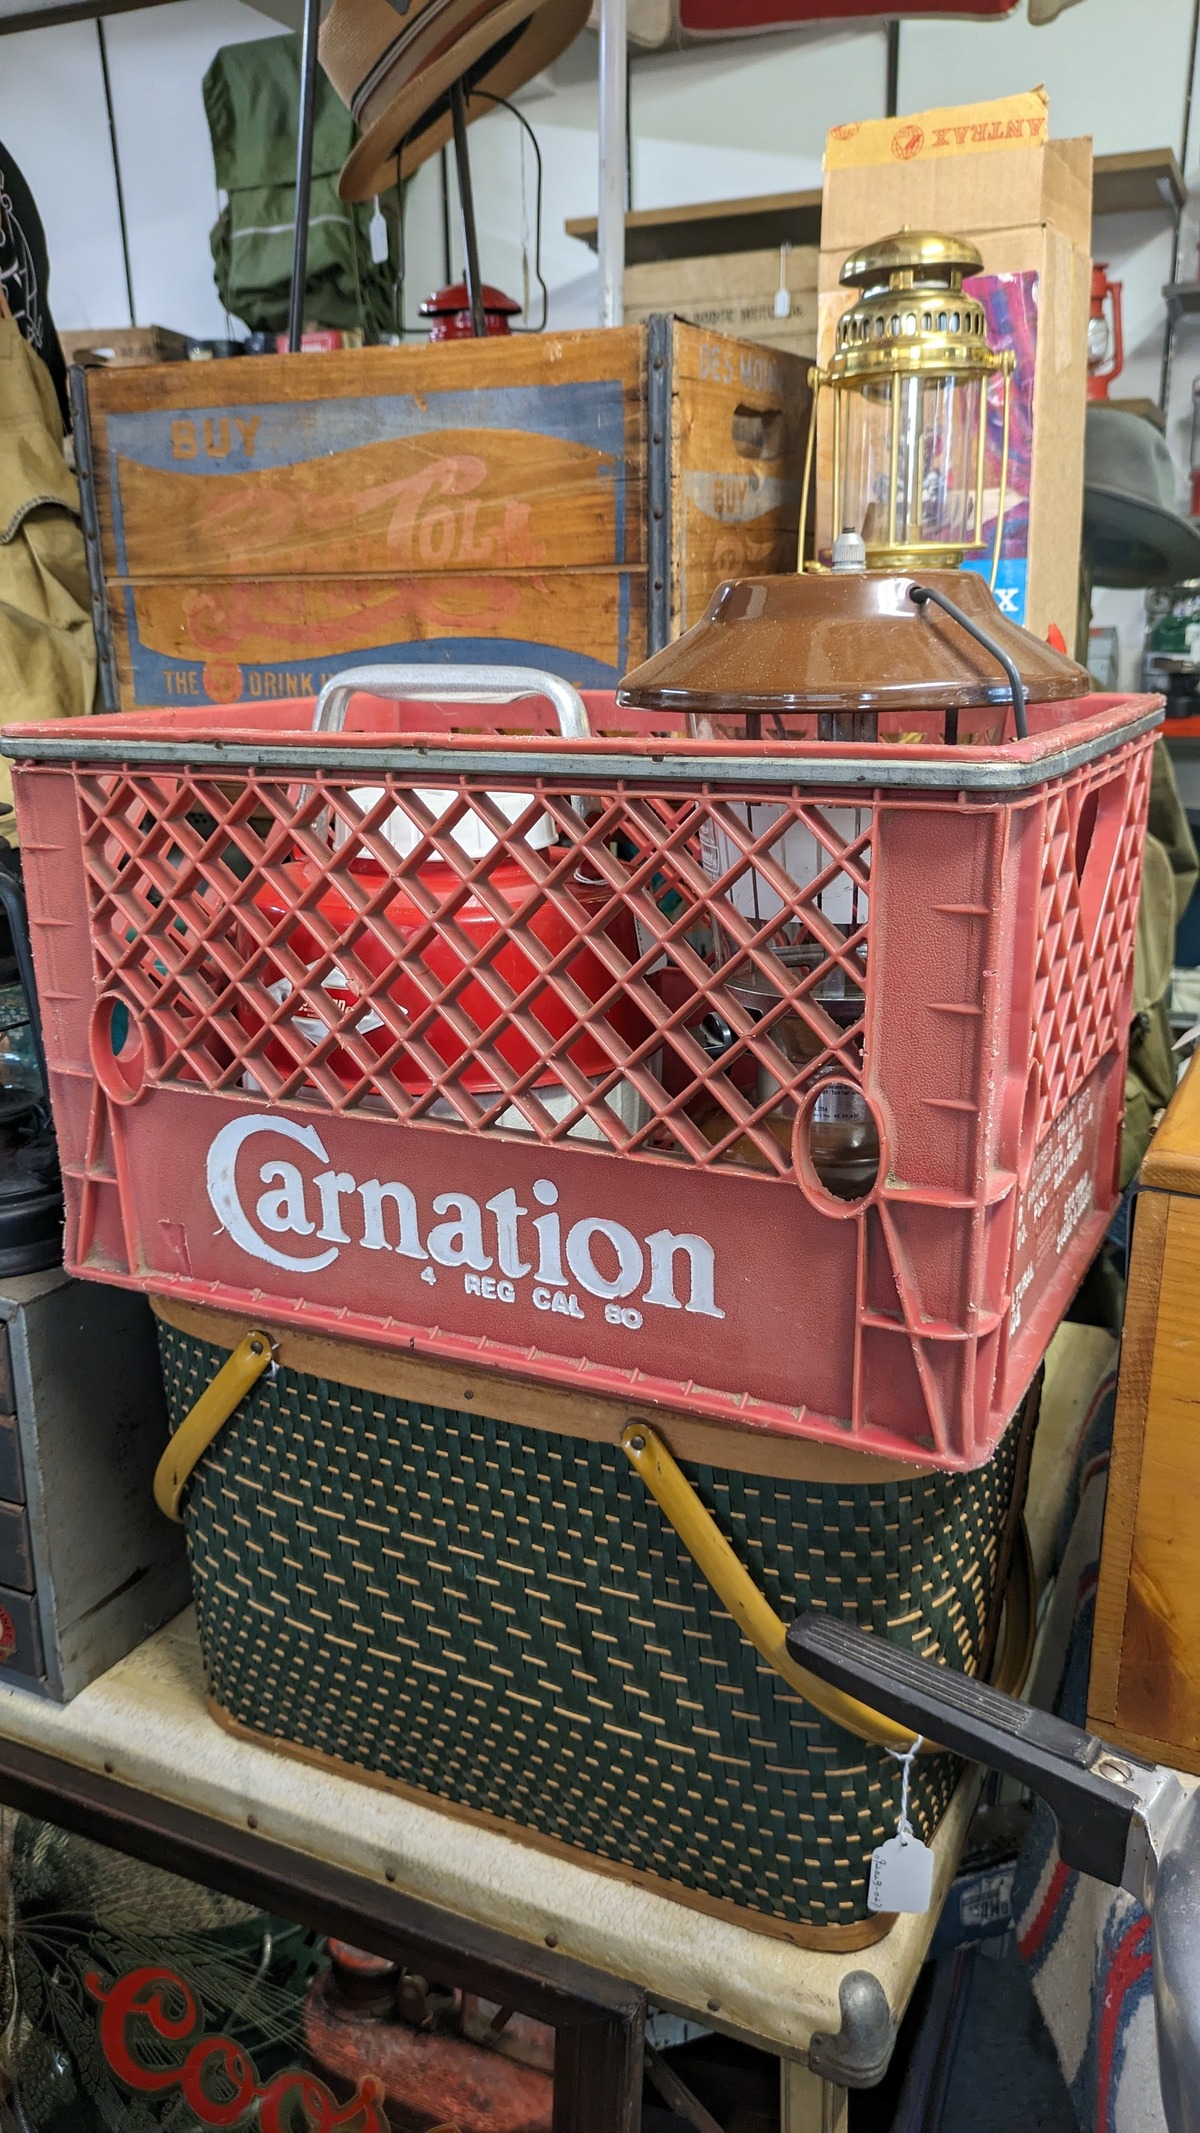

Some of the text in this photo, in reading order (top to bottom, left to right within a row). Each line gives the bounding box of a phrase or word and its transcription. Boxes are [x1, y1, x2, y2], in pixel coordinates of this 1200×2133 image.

[171, 415, 261, 460] BUY
[713, 479, 748, 514] BUY
[162, 669, 200, 696] THE
[248, 671, 315, 697] DRINK
[206, 1114, 725, 1319] Carnation
[420, 1266, 644, 1330] 4 REG CAL 80
